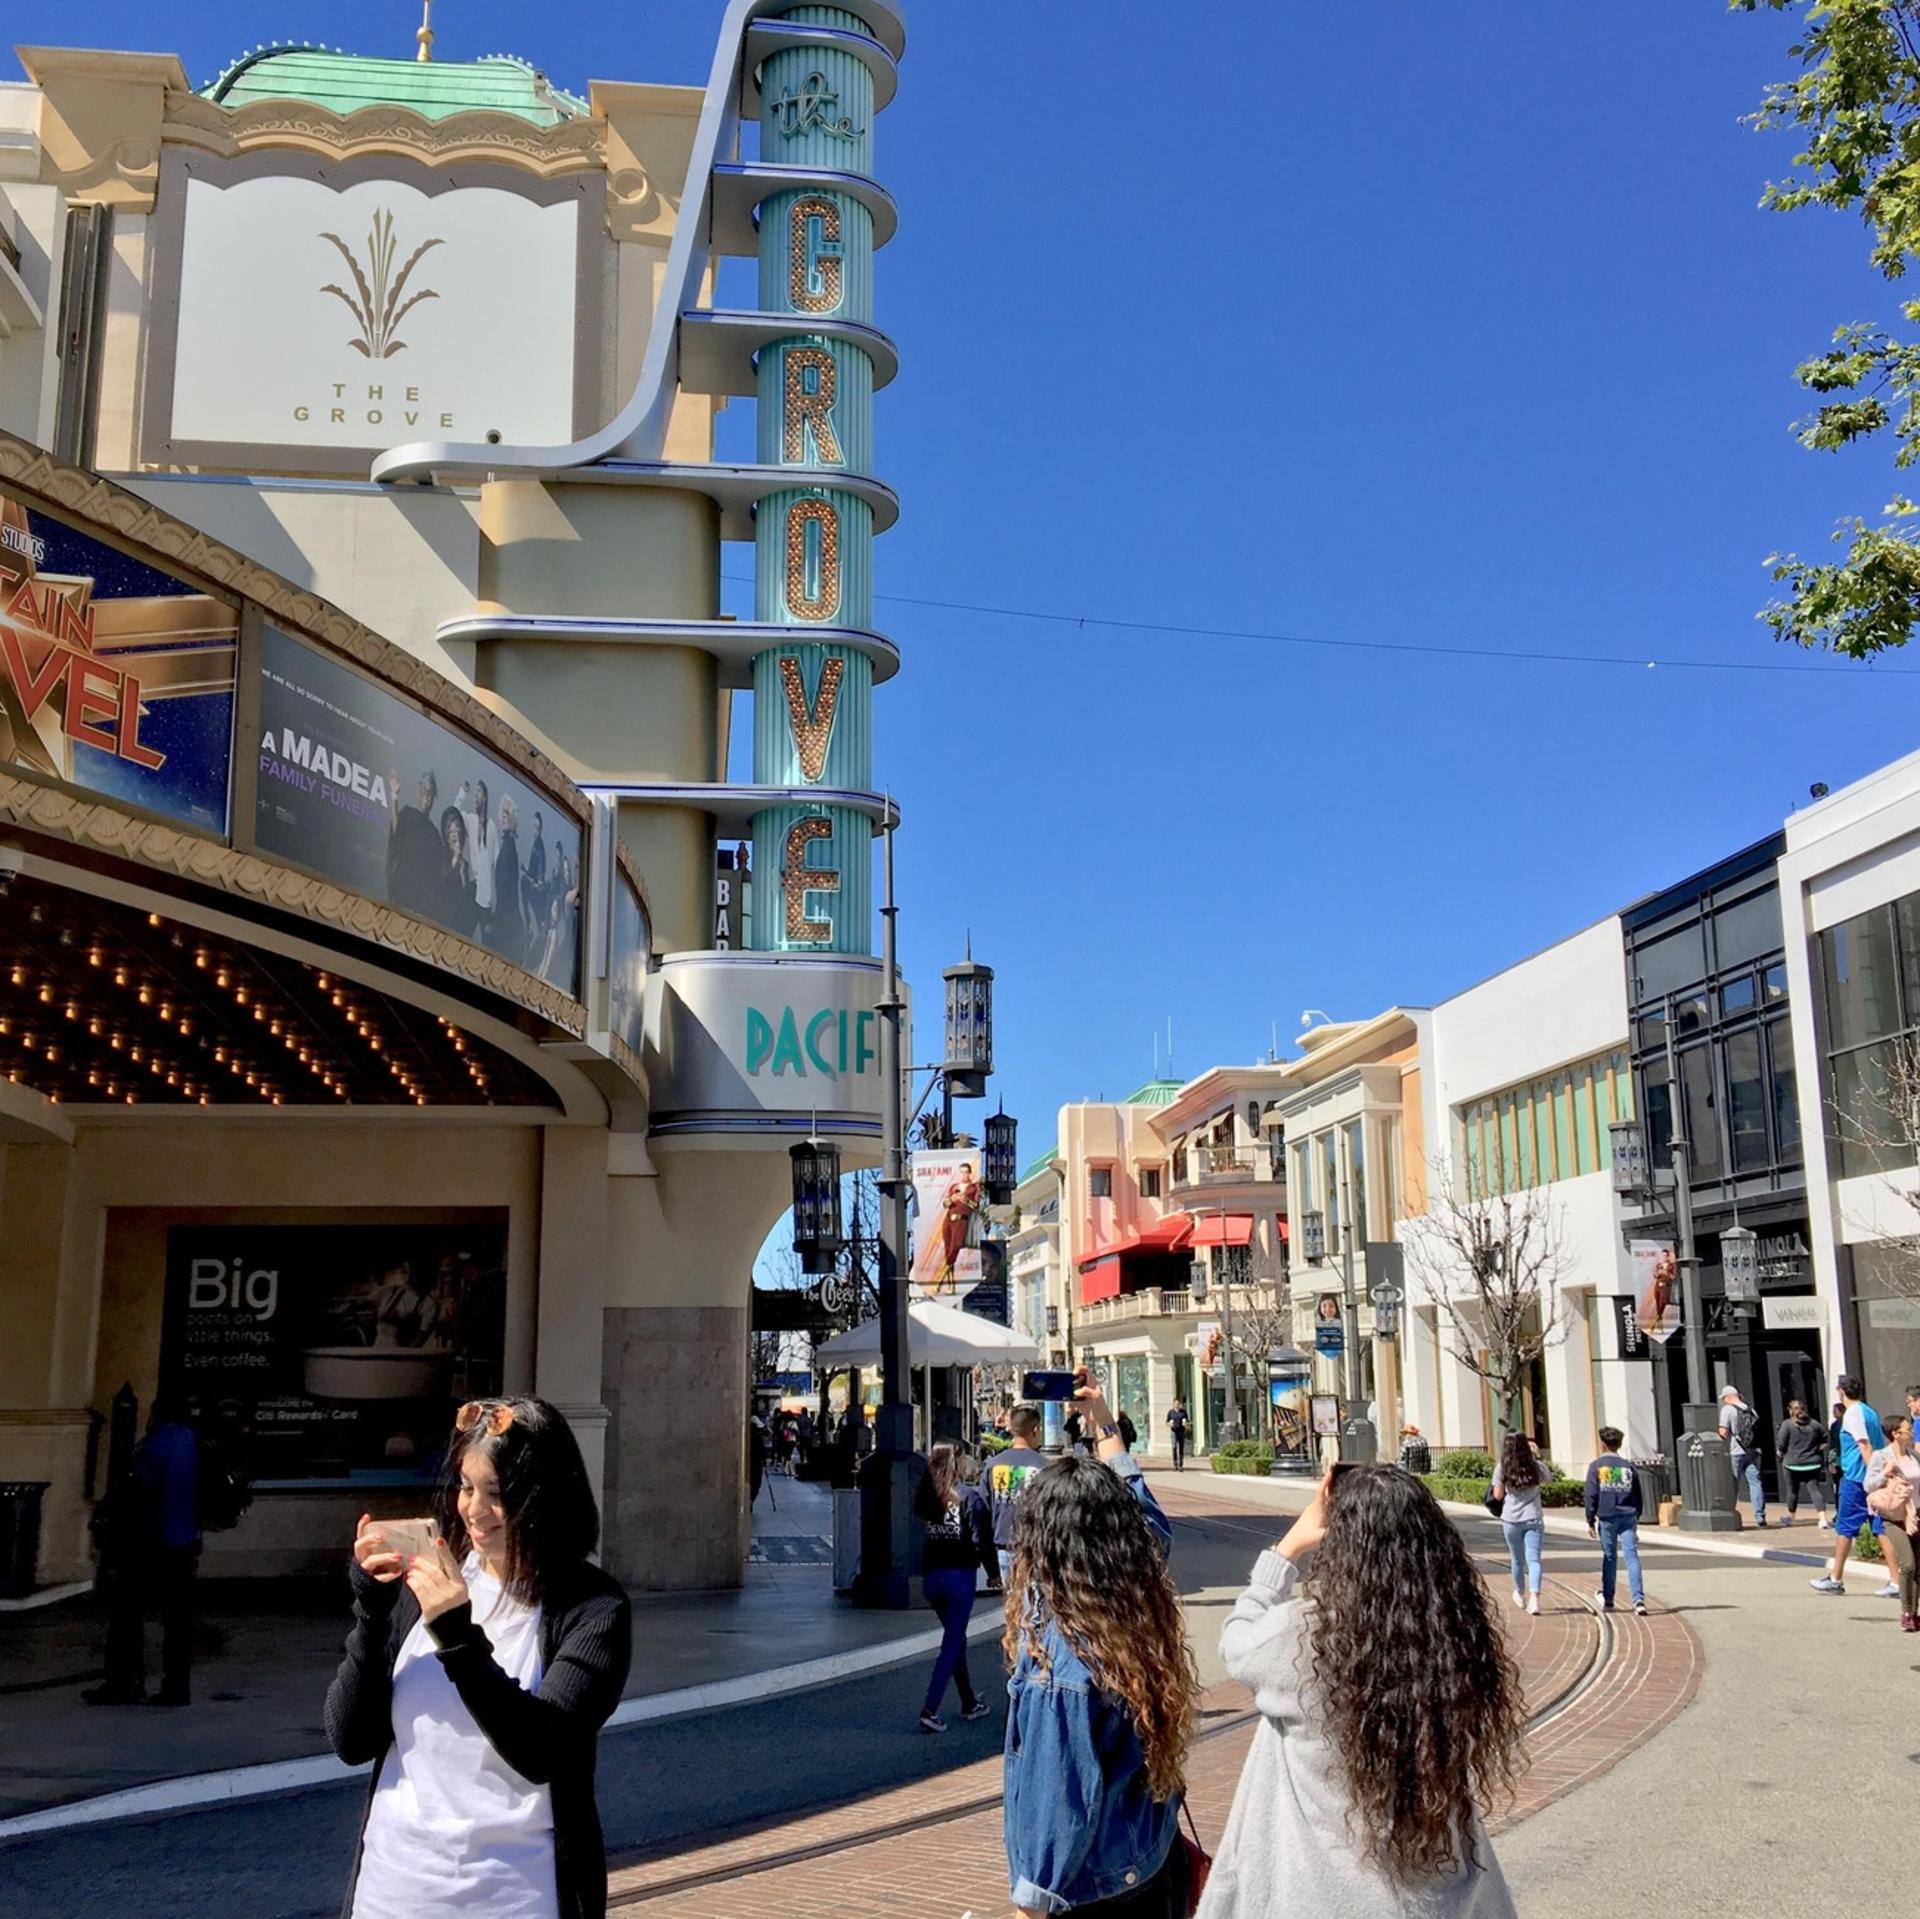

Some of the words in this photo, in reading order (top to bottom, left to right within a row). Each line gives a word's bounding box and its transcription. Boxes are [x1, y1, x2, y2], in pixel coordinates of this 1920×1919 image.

[770, 71, 866, 138] the
[332, 383, 419, 402] THE
[293, 406, 454, 428] GROVE
[1, 524, 45, 563] STUDIOS
[780, 194, 847, 943] GROVE
[285, 681, 296, 691] ALL
[260, 754, 318, 794] FAMILY
[261, 730, 277, 754] A
[282, 727, 388, 808] MADEA
[746, 1006, 904, 1080] PACIF
[1755, 1231, 1811, 1259] HINOLA
[189, 1257, 279, 1321] Big
[233, 1313, 254, 1325] on
[223, 1328, 275, 1345] things.
[184, 1353, 220, 1368] Even
[222, 1353, 271, 1367] coffee.
[331, 1409, 358, 1420] Card
